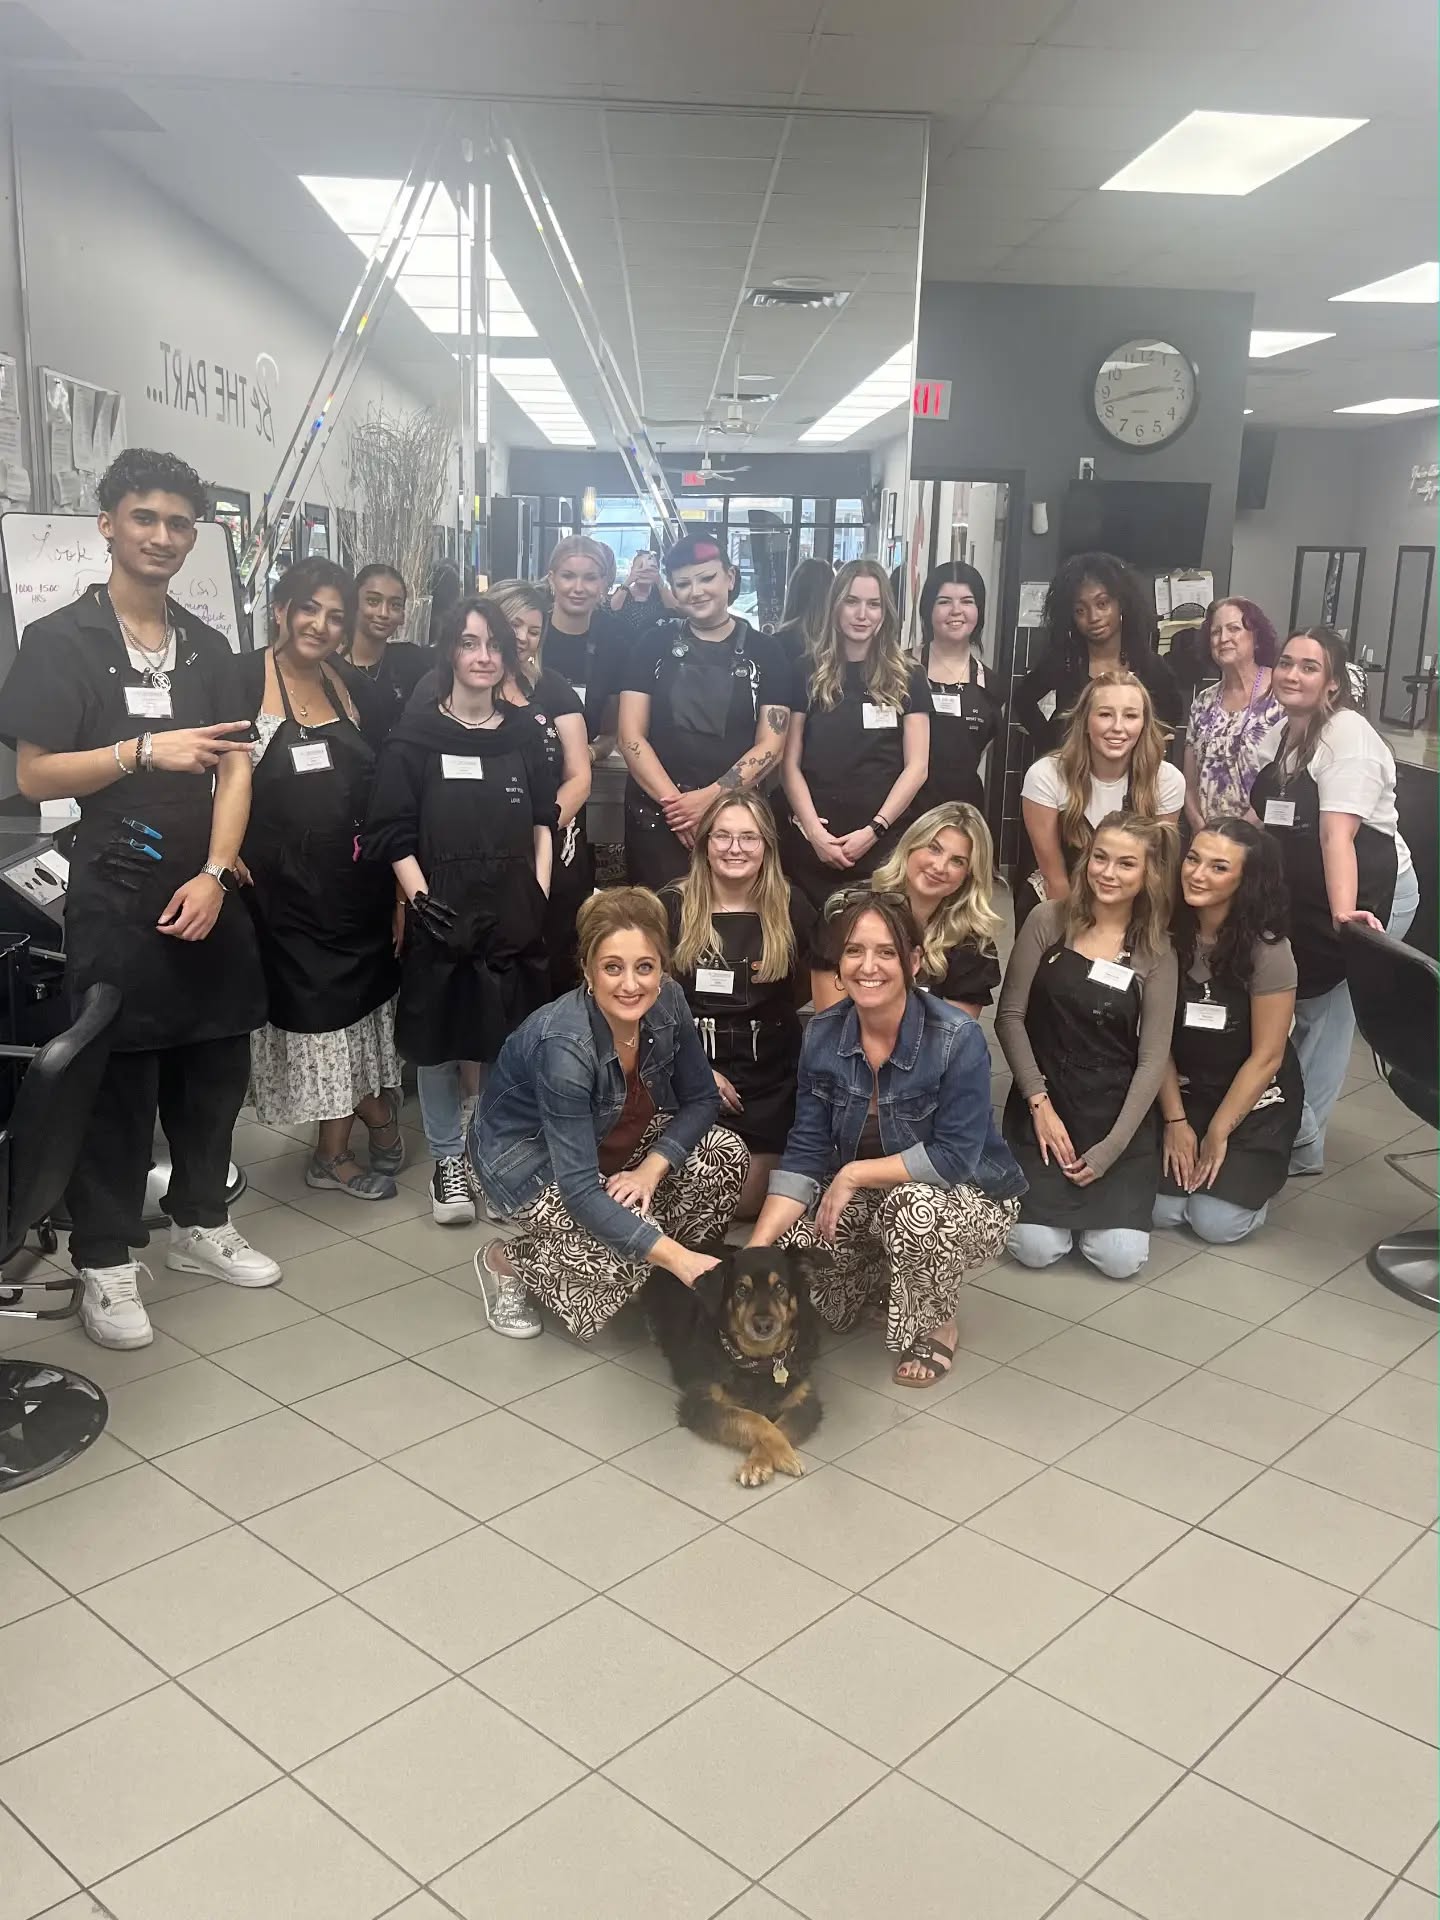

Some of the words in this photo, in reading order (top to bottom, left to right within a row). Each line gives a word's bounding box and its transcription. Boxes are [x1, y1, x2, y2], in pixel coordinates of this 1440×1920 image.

[1141, 350, 1154, 361] 12
[1108, 365, 1122, 381] 10
[1173, 369, 1182, 382] 2
[1101, 385, 1111, 399] 9
[1176, 387, 1185, 400] 3
[1104, 404, 1115, 418] 8
[1166, 406, 1176, 420] 4
[1119, 418, 1129, 432] 7
[1135, 424, 1145, 437] 6
[1152, 420, 1162, 433] 5
